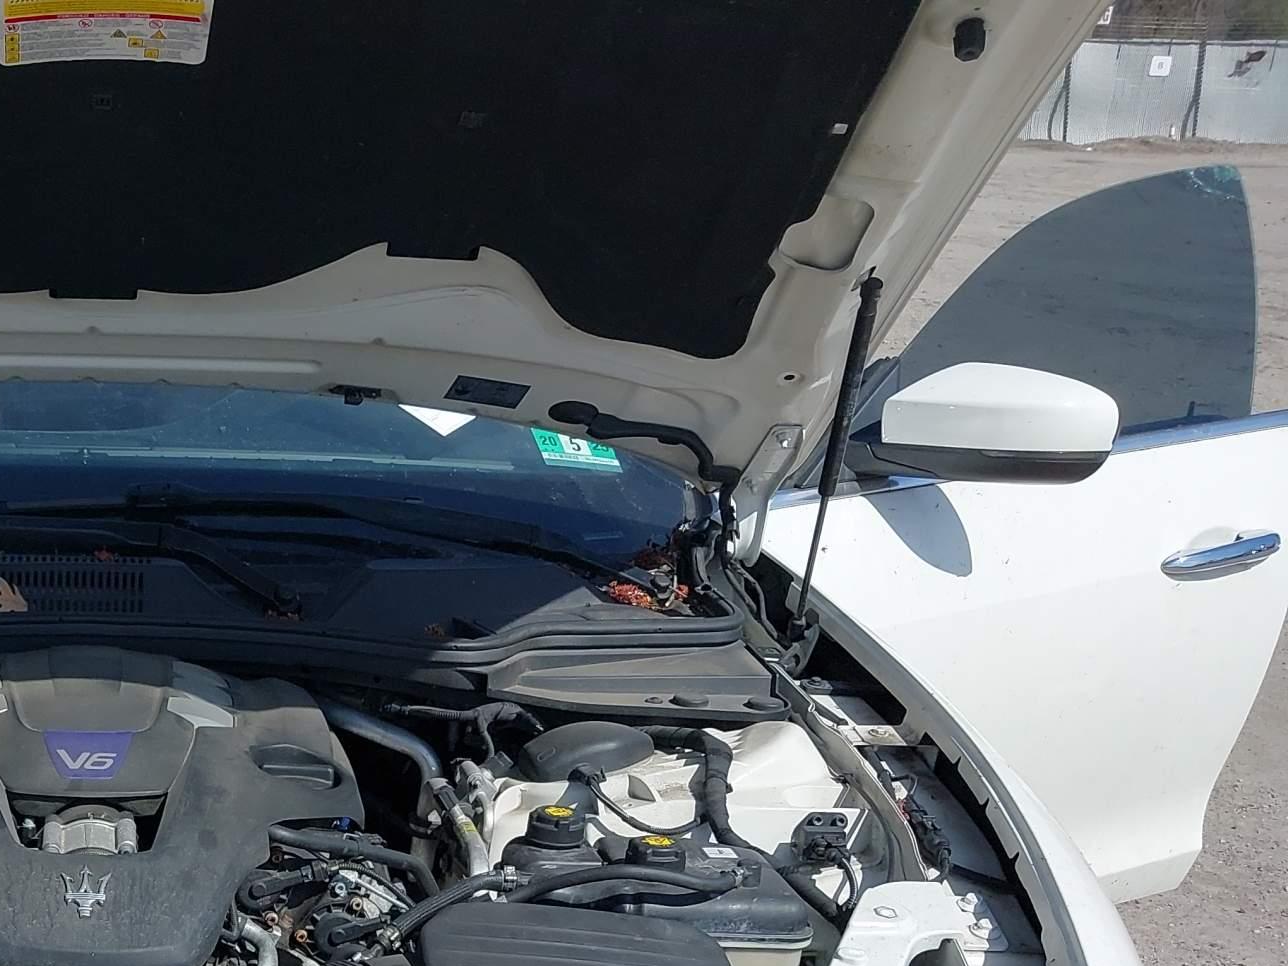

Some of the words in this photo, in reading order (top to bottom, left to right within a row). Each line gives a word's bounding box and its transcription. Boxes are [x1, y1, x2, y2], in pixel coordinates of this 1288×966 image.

[539, 435, 557, 446] 20
[569, 437, 582, 452] 5
[56, 749, 117, 770] V6
